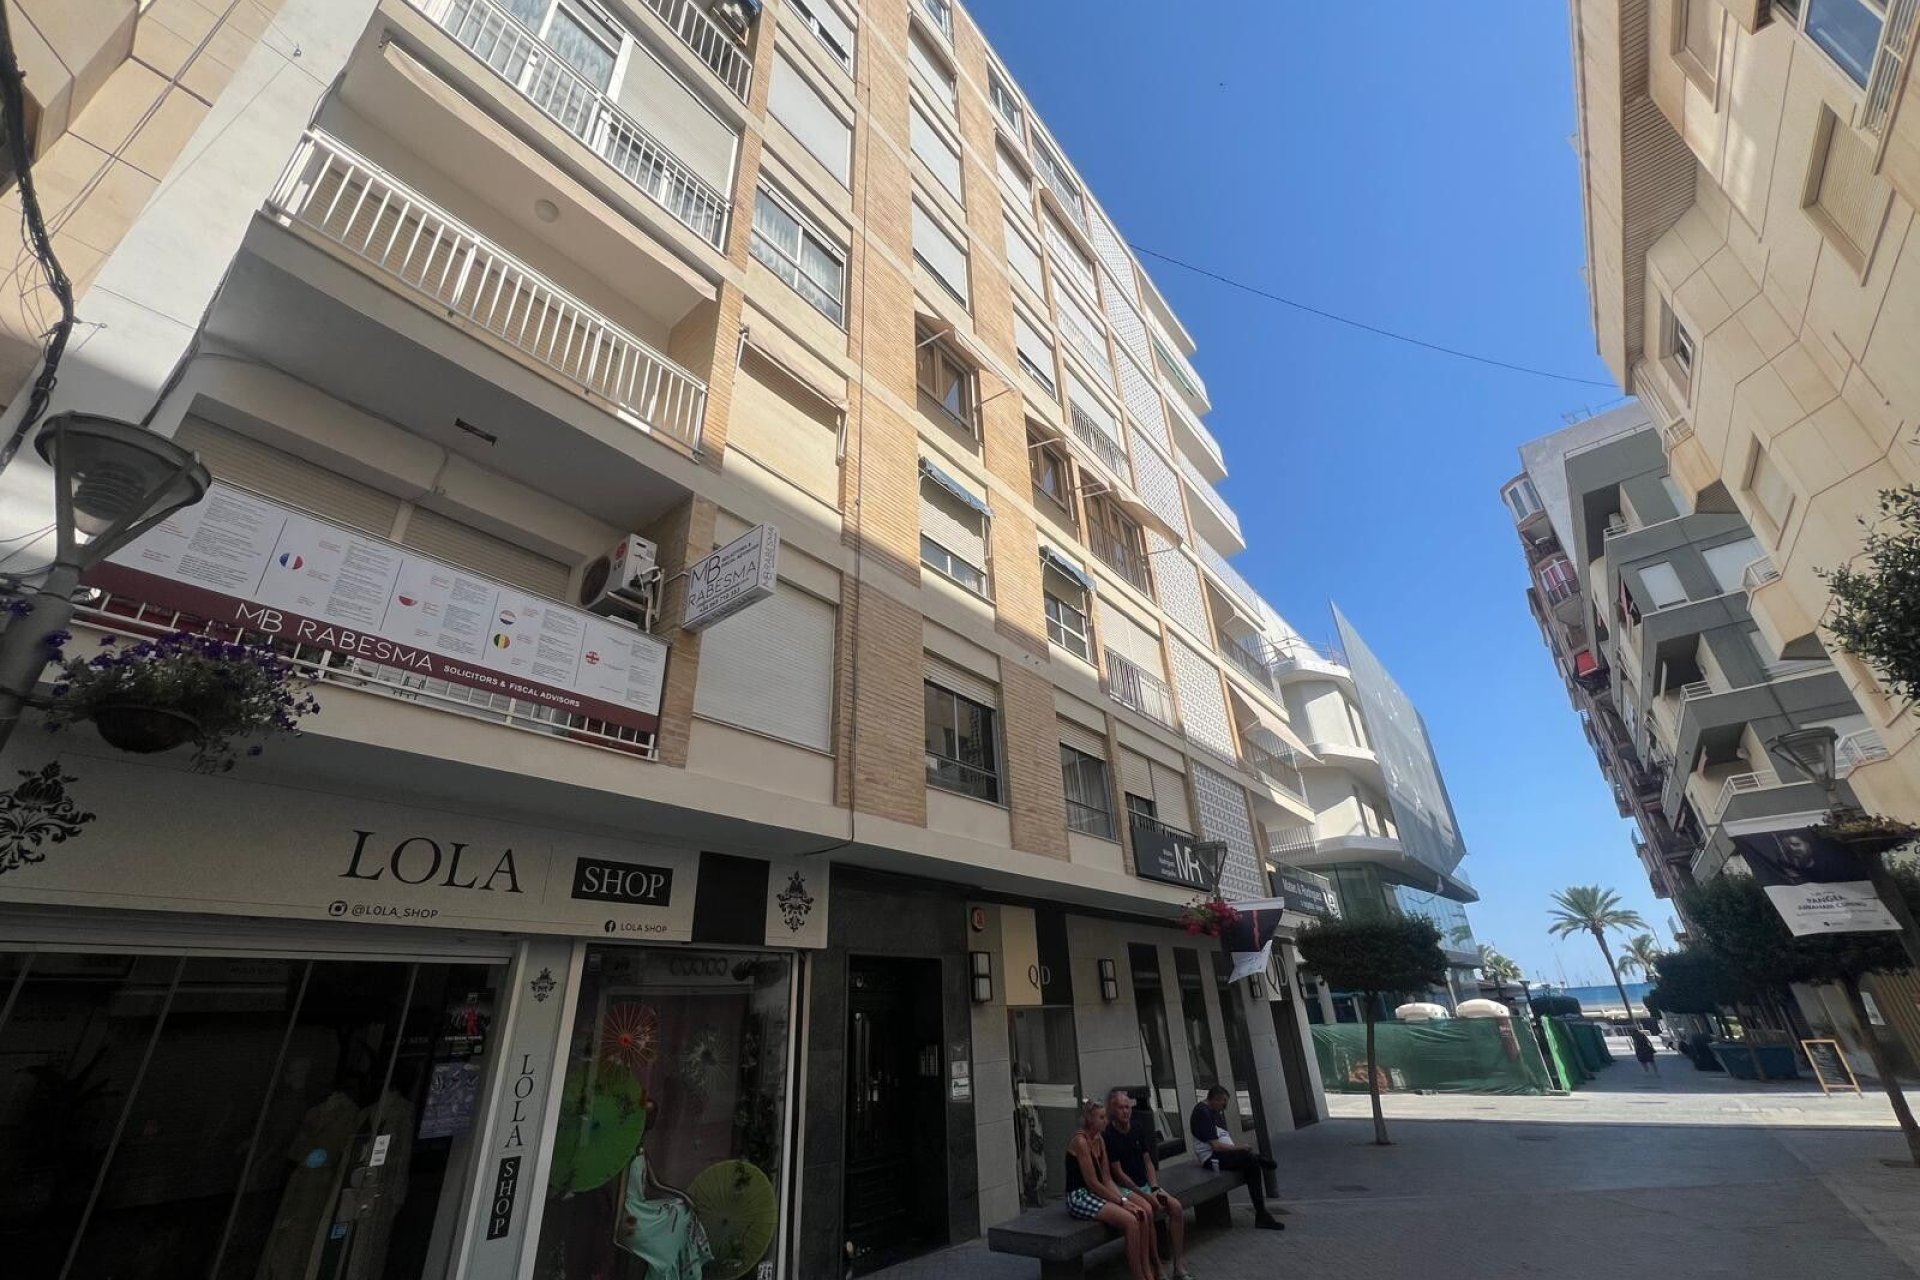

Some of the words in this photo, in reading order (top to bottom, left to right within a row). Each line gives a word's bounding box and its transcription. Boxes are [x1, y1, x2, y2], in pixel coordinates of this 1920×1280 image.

[689, 560, 758, 606] RABESMA
[691, 556, 720, 589] MB
[235, 603, 283, 633] MB
[297, 619, 433, 672] RABESMA
[443, 664, 498, 685] SOLICITORS
[500, 680, 506, 688] &
[509, 682, 538, 697] FISCAL
[540, 690, 581, 707] ADVISORS
[338, 829, 524, 894] LOLA
[582, 866, 665, 899] SHOP
[352, 904, 439, 919] @LOLA_SHOP
[621, 922, 642, 932] LOLA
[644, 924, 667, 933] SHOP
[505, 1054, 535, 1148] LOLA
[494, 1161, 514, 1235] SHOP
